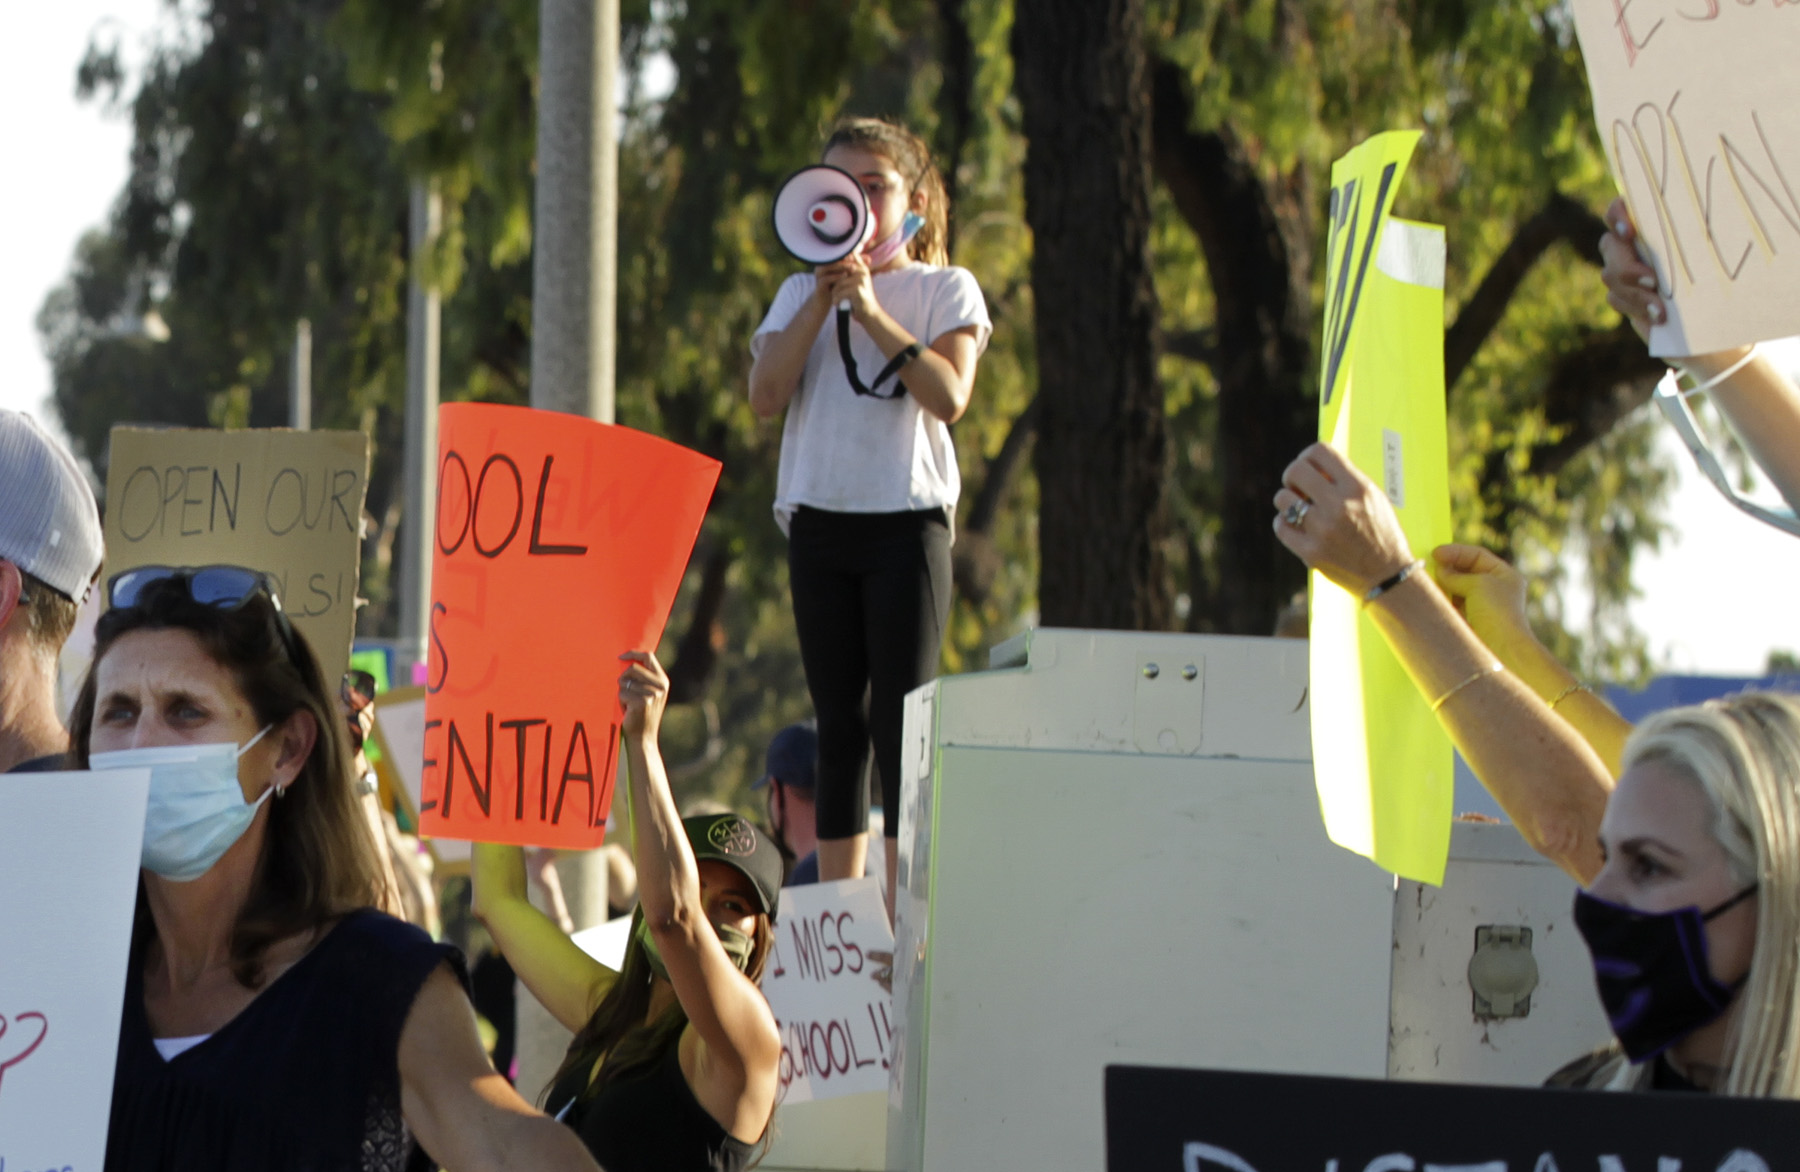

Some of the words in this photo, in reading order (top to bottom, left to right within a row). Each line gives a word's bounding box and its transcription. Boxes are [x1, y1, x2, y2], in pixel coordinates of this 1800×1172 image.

[119, 462, 241, 543] OPEN
[265, 467, 358, 537] OUR
[790, 910, 864, 983] MISS
